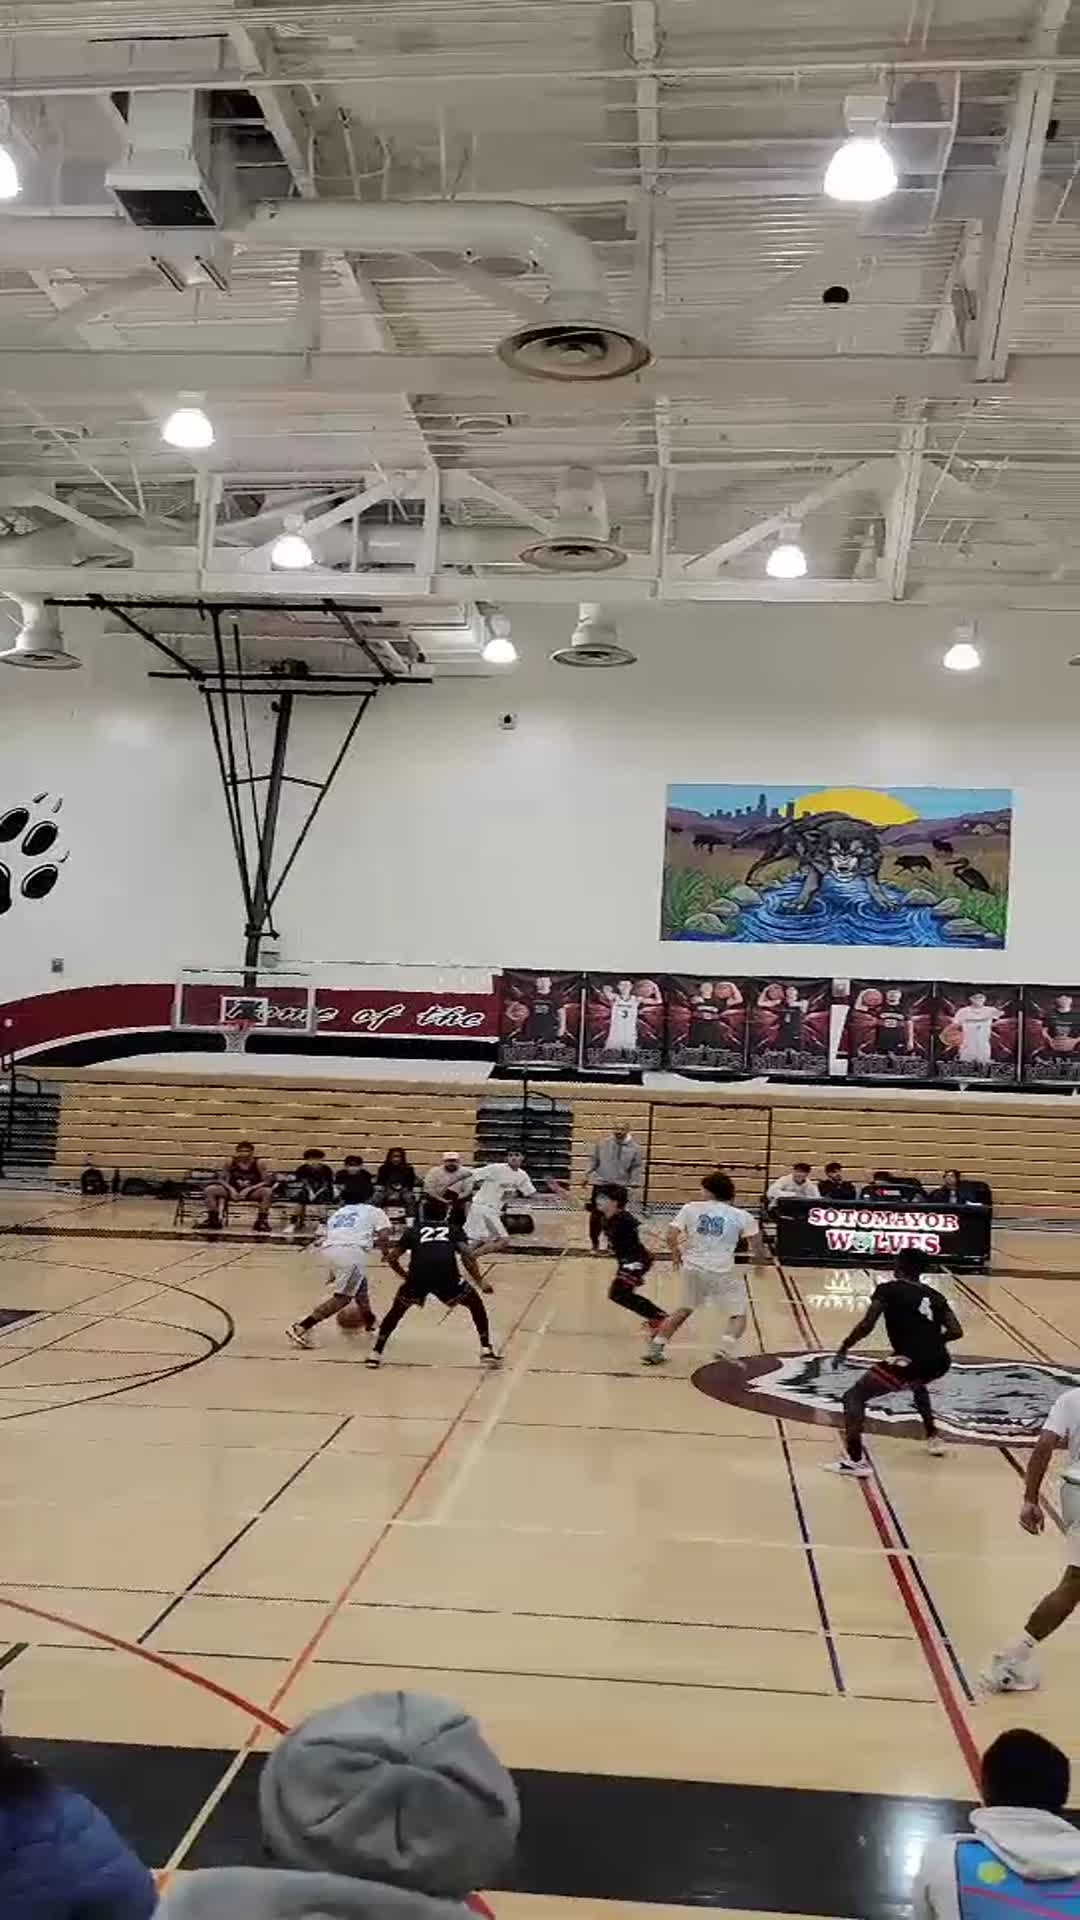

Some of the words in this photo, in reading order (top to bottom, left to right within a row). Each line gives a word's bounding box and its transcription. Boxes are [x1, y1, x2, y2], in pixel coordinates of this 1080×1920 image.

[351, 1003, 406, 1031] of
[416, 1003, 486, 1028] the
[808, 1207, 960, 1232] SOTOMAYOR
[420, 1226, 450, 1244] 22
[918, 1296, 935, 1322] 4
